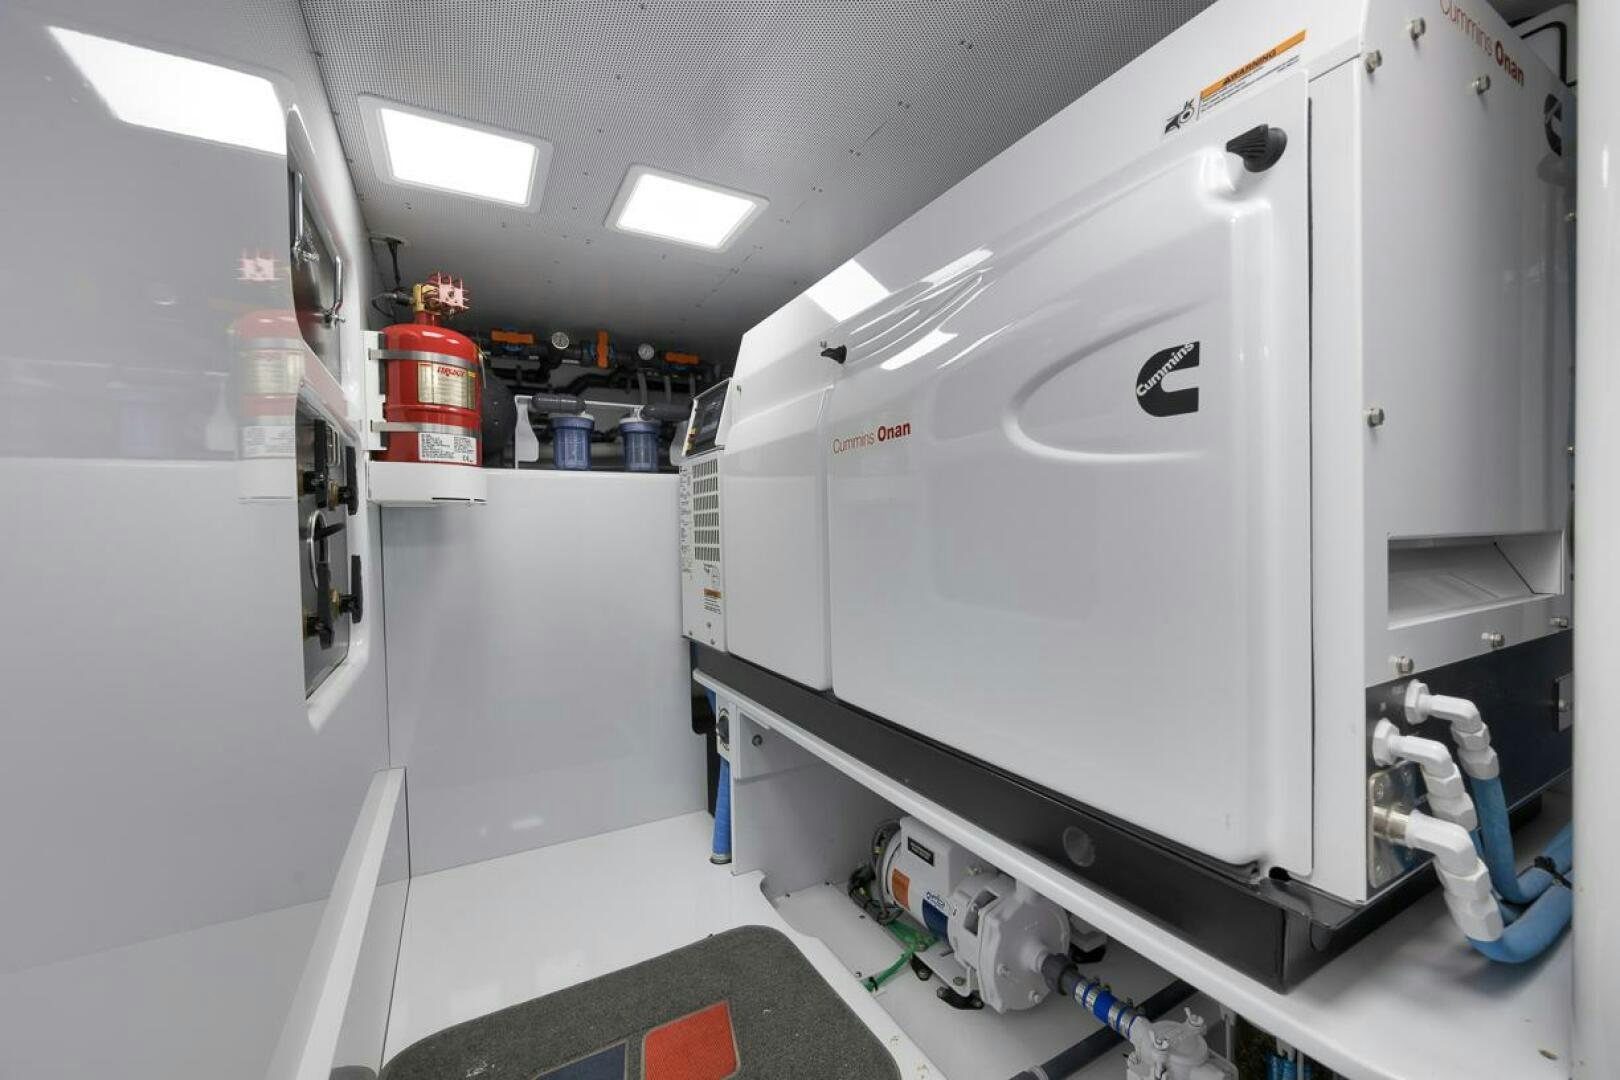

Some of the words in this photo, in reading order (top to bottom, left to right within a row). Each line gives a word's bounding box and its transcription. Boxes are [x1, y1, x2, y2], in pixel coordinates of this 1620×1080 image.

[1494, 40, 1525, 86] Onan
[1136, 342, 1195, 397] Cummins
[832, 431, 876, 455] Cummins
[877, 422, 912, 442] Onan
